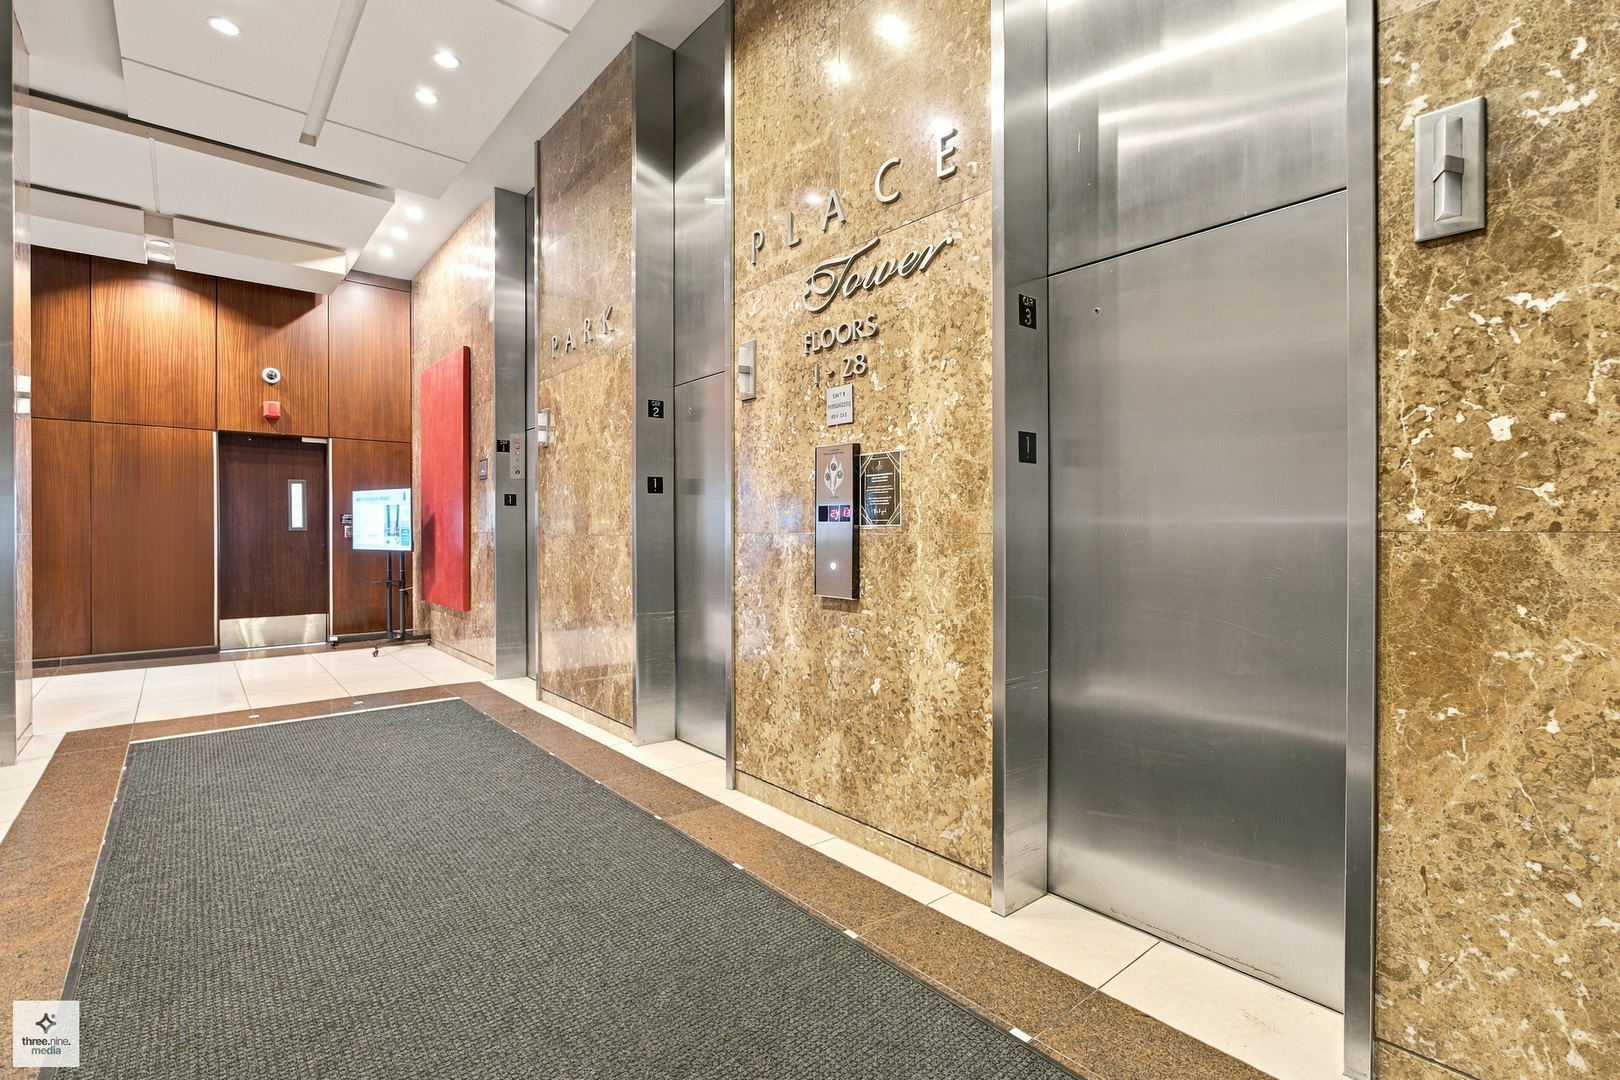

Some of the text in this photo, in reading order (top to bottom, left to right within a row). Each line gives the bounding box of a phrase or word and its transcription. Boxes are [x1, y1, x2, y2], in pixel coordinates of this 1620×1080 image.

[750, 127, 959, 265] PLACE
[802, 236, 956, 314] Tower
[551, 305, 615, 360] PARK
[803, 313, 880, 356] FLOORS
[1024, 308, 1032, 325] 3
[813, 362, 820, 387] 1
[842, 353, 868, 380] 28
[653, 407, 660, 417] 2
